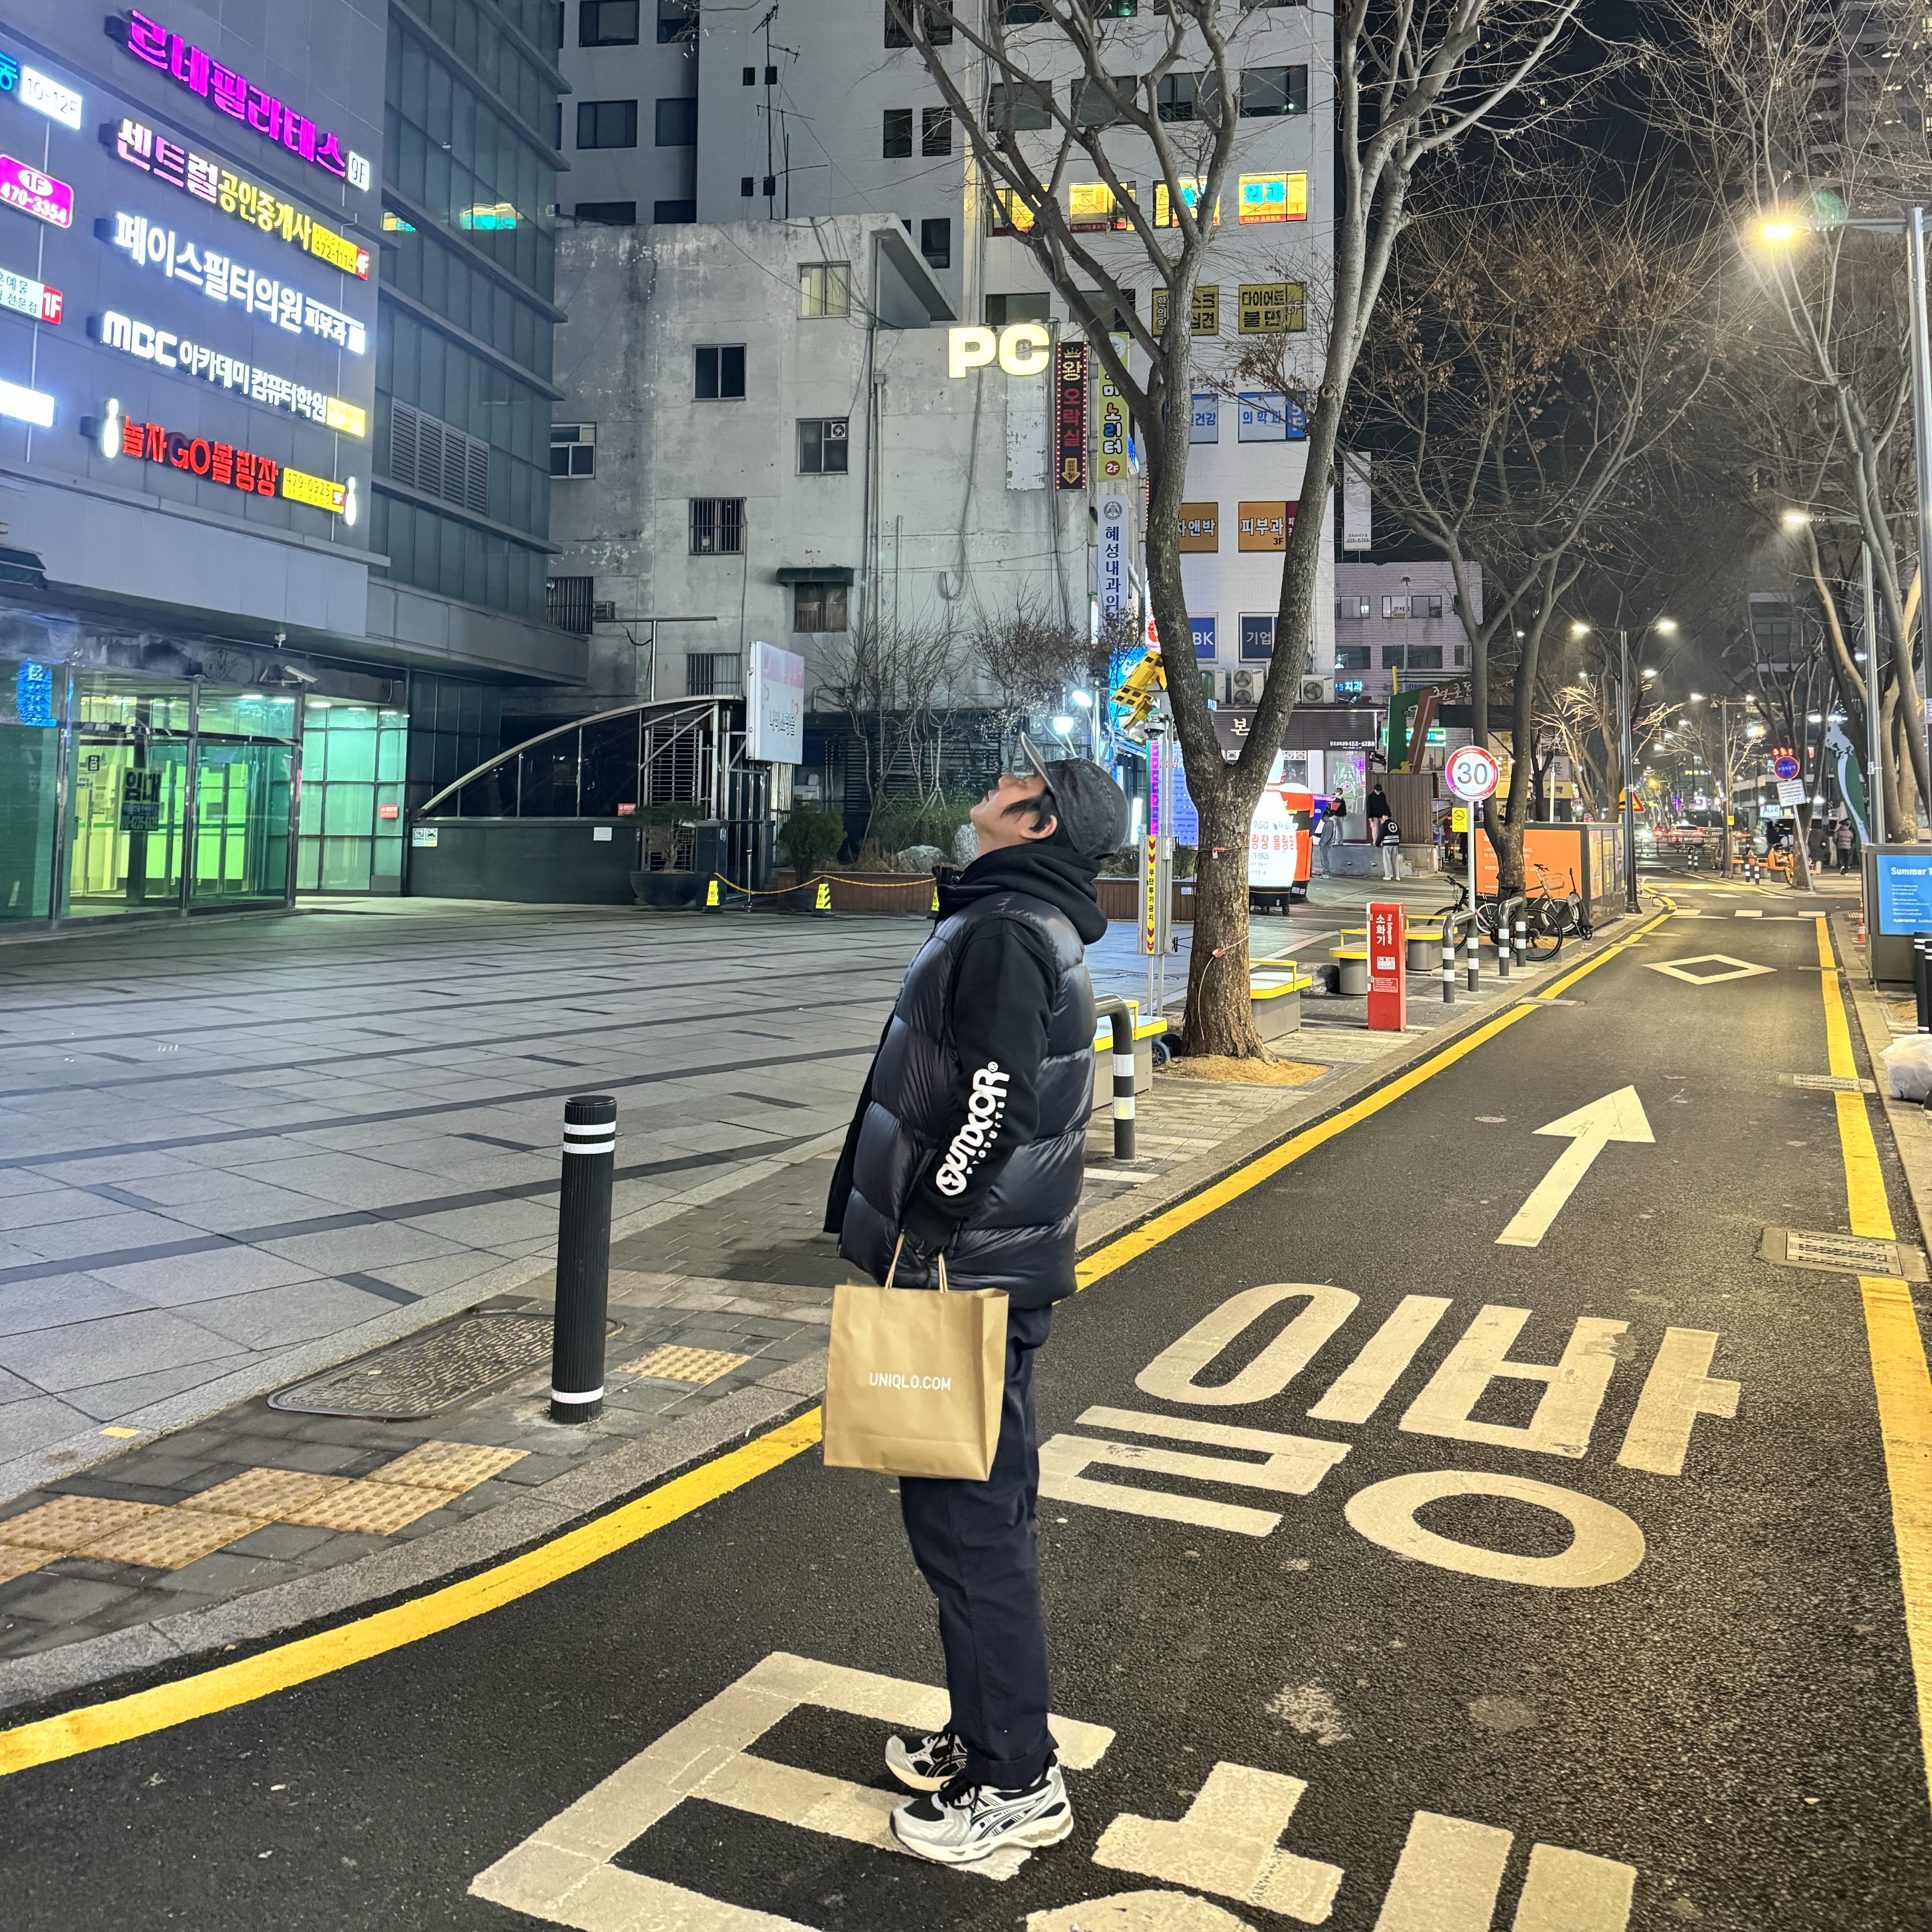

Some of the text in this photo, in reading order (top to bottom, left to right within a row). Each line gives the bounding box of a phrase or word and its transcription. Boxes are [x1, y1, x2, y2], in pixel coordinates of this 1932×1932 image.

[28, 78, 77, 115] 10-12F
[128, 9, 367, 186] 르네필라테스 9F
[27, 174, 45, 190] 1F
[117, 118, 312, 250] 센트럴 공인중개사
[0, 182, 67, 224] 470-3354
[315, 240, 353, 270] 472-1114
[115, 212, 303, 334] 페이스필터의원
[43, 292, 61, 318] 1F
[1242, 290, 1284, 307] 다이어트
[103, 311, 178, 367] MBC
[179, 341, 249, 394] 아카데미
[251, 368, 327, 423] 컴퓨터학원
[949, 324, 1049, 378] PC
[1062, 361, 1083, 447] 왕 오락실
[1103, 402, 1122, 454] 노리터
[1107, 464, 1119, 473] 2F
[1241, 518, 1283, 536] 피부과
[1106, 526, 1120, 625] 혜성내과의
[1246, 632, 1271, 645] 기업
[125, 771, 161, 803] 임대
[1457, 762, 1488, 785] 30
[1891, 867, 1927, 875] Summer
[1376, 914, 1386, 946] 소화기
[870, 1372, 951, 1390] UNIQLO.COM
[1037, 1283, 1740, 1588] 일방
